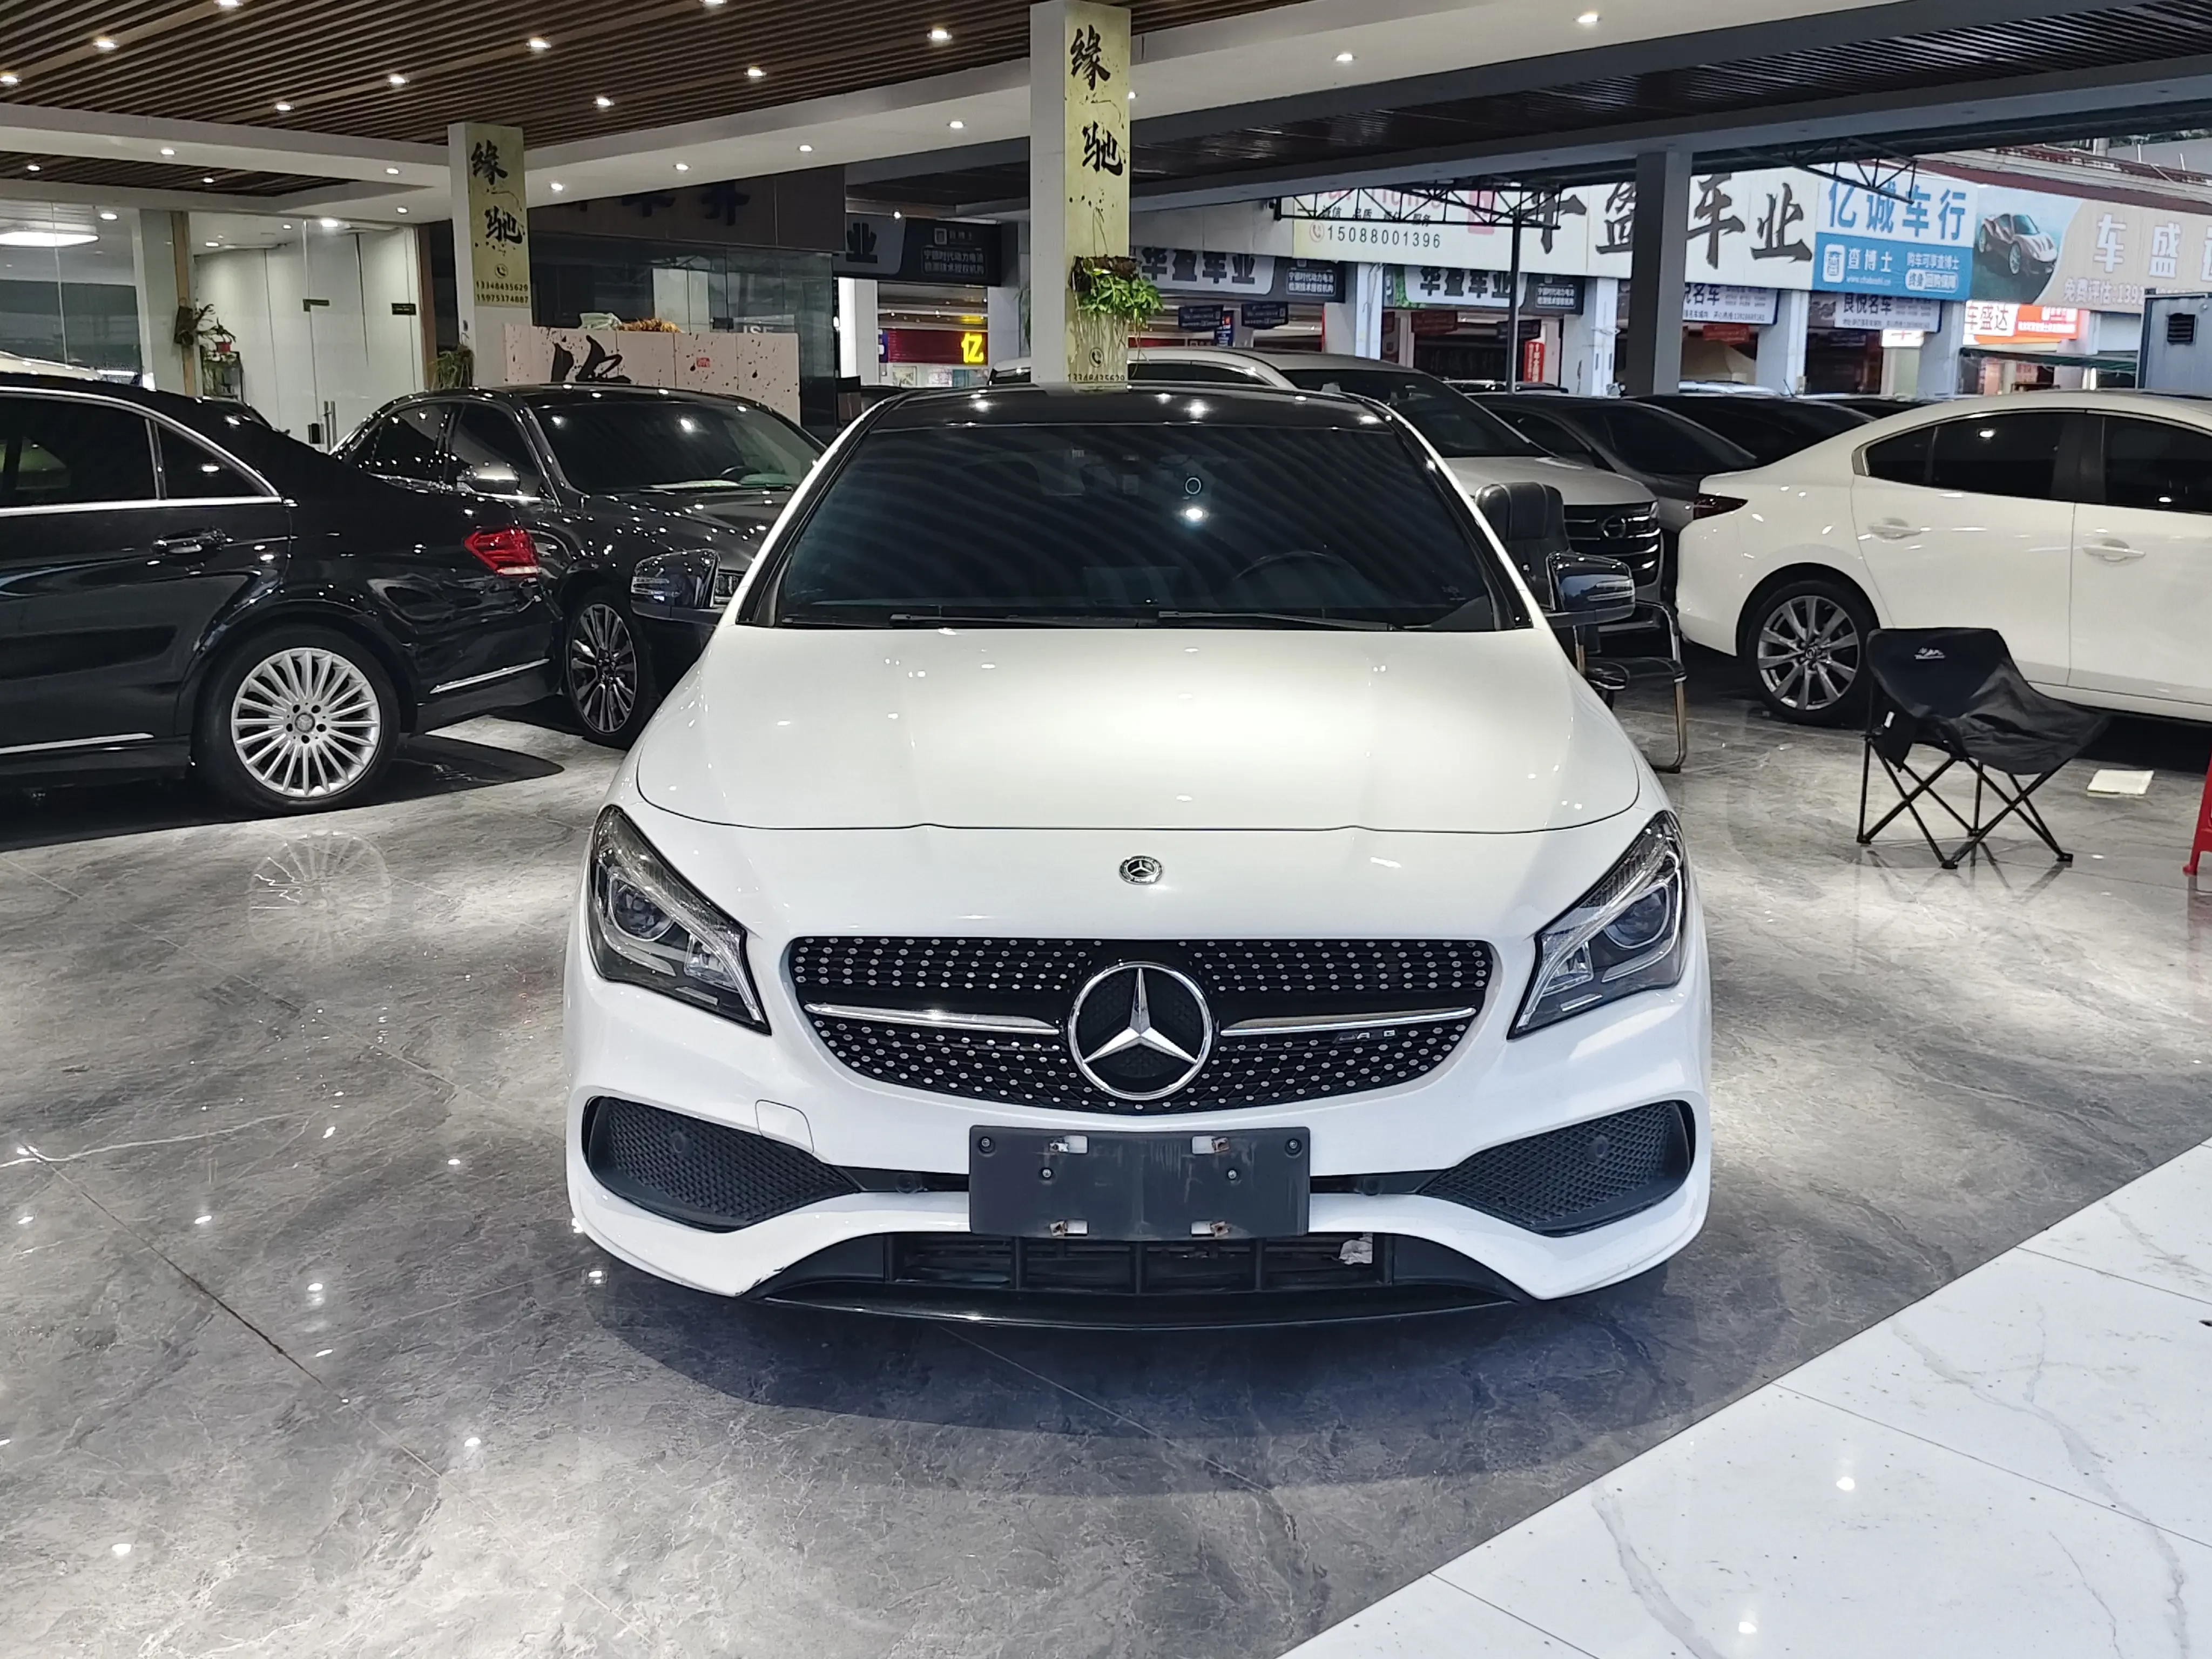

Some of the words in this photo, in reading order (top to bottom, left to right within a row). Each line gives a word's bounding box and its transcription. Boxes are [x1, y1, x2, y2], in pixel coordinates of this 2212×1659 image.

[1829, 180, 1967, 240] 亿诚车行
[1327, 225, 1440, 248] 15088001396
[961, 332, 984, 363] 亿
